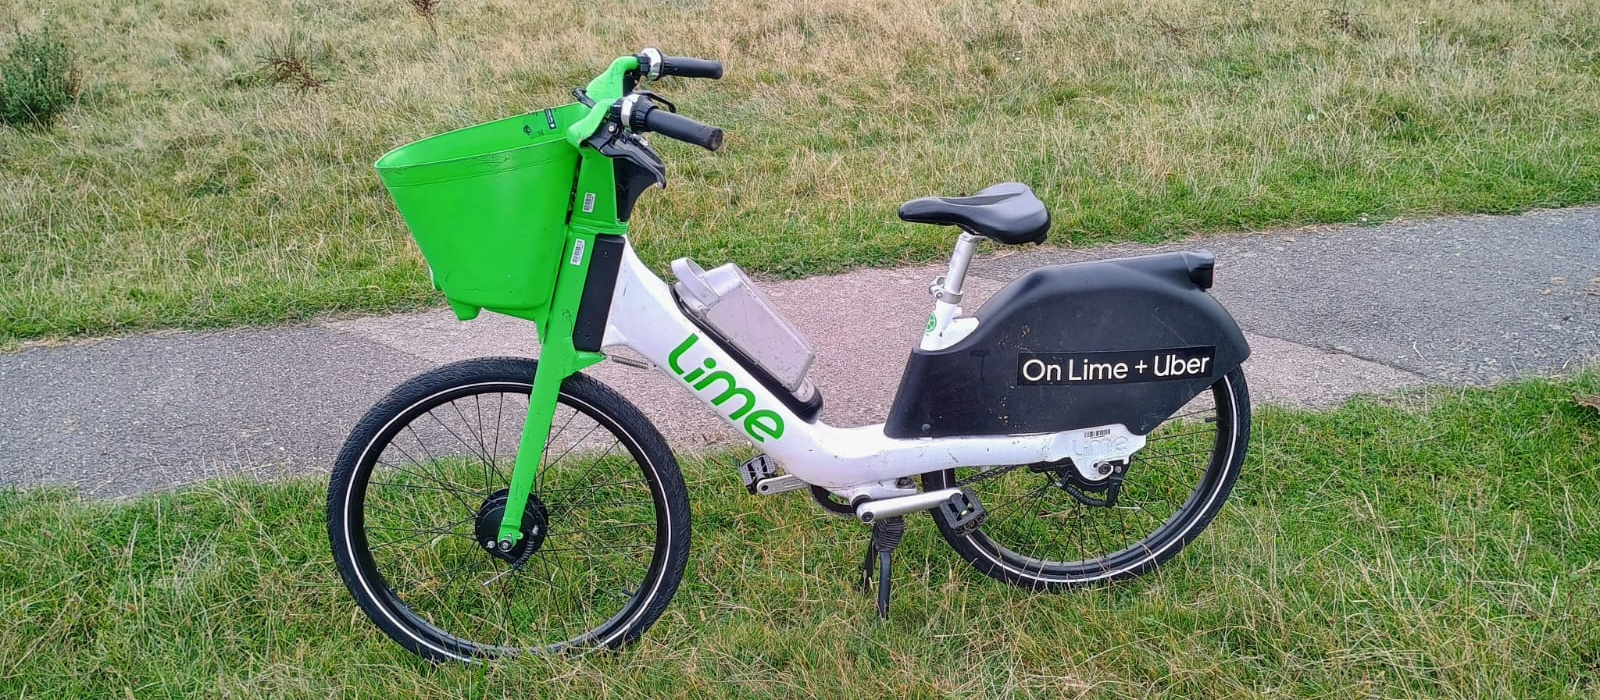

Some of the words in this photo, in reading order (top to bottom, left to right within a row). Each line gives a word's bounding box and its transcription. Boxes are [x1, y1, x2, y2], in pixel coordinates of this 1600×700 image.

[668, 332, 785, 443] Lime
[1022, 358, 1062, 382] On
[1068, 358, 1129, 381] Lime
[1134, 359, 1148, 374] +
[1153, 354, 1210, 377] Uber
